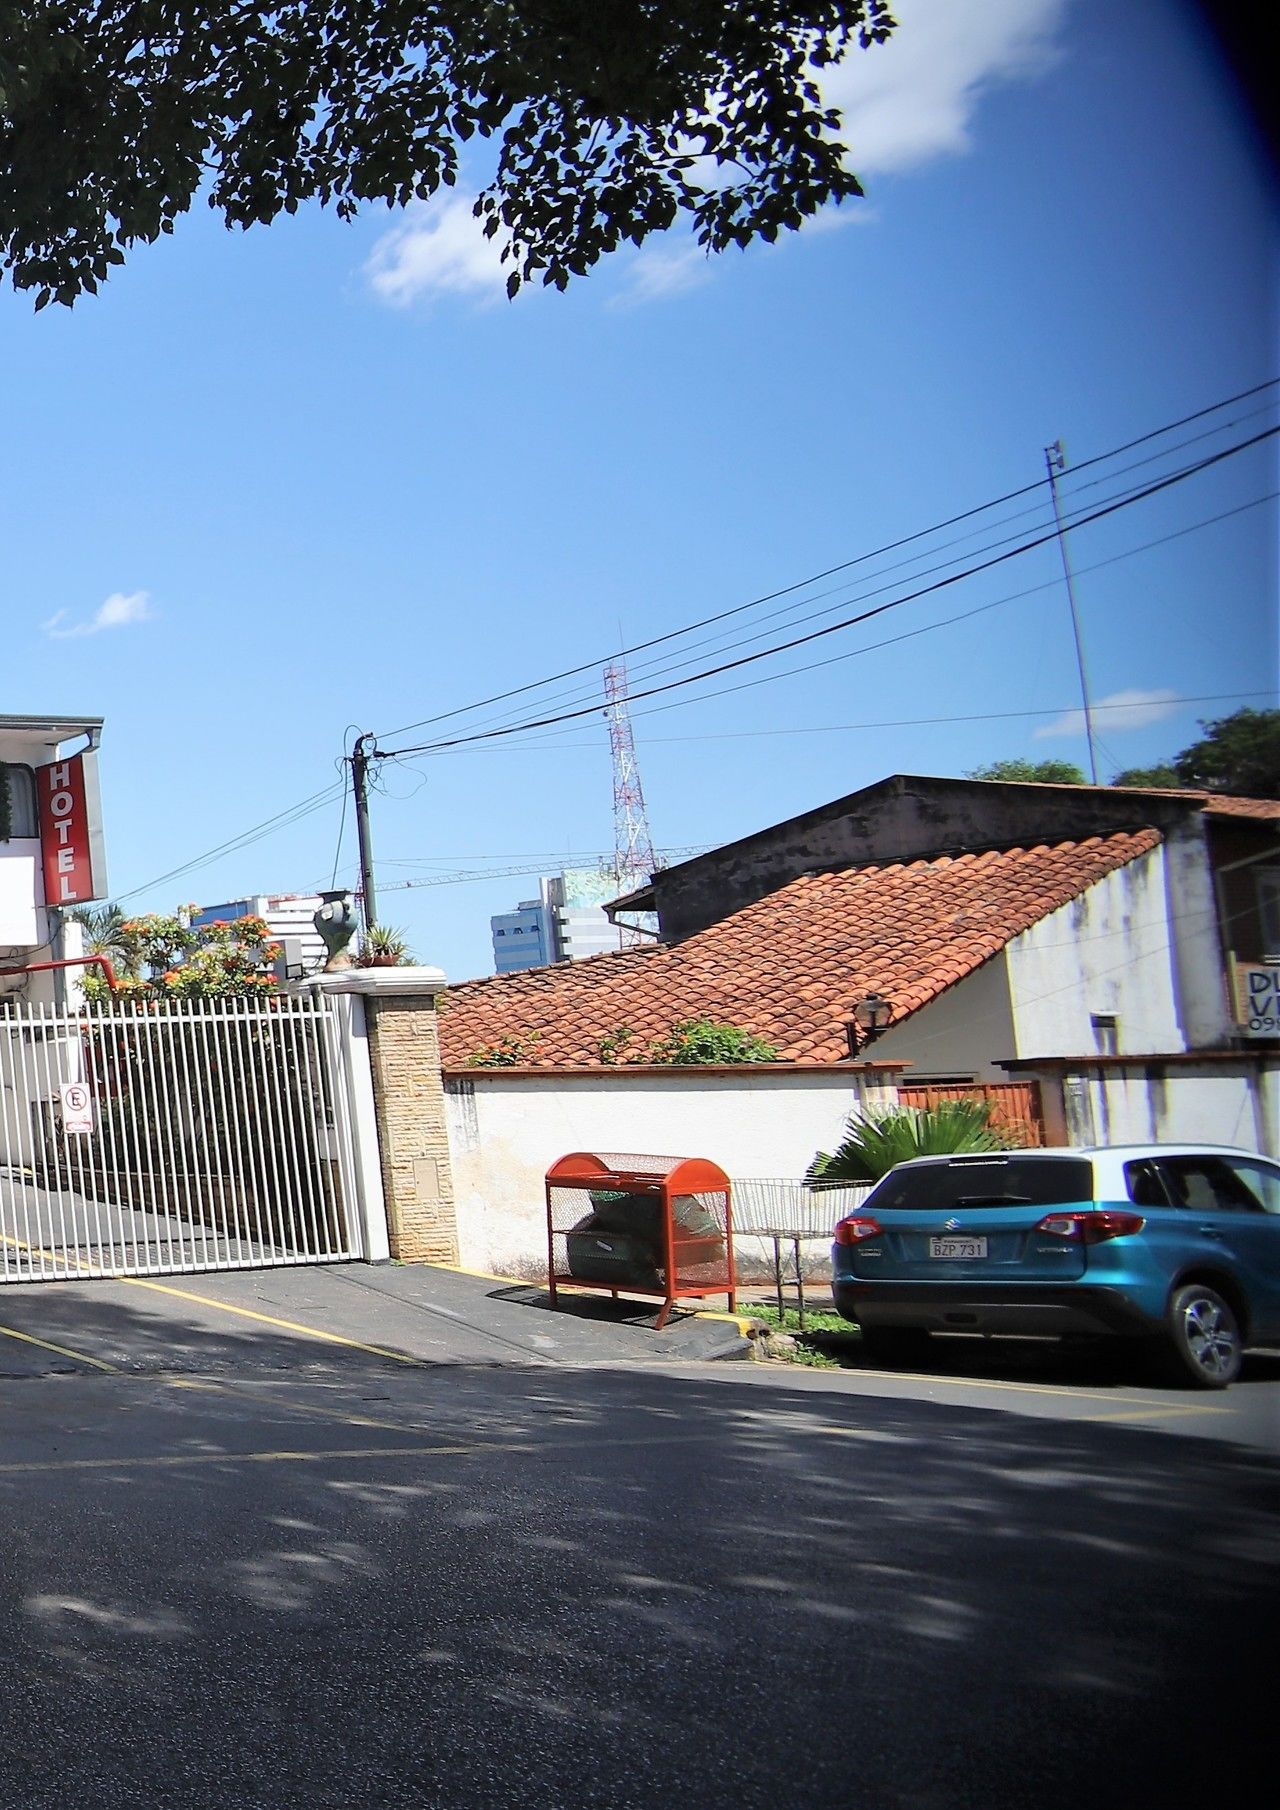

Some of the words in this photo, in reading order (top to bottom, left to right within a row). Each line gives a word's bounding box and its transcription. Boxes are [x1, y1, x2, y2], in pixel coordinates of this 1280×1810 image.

[49, 762, 77, 901] HOTEL
[71, 1092, 81, 1107] E
[960, 1244, 982, 1256] 731
